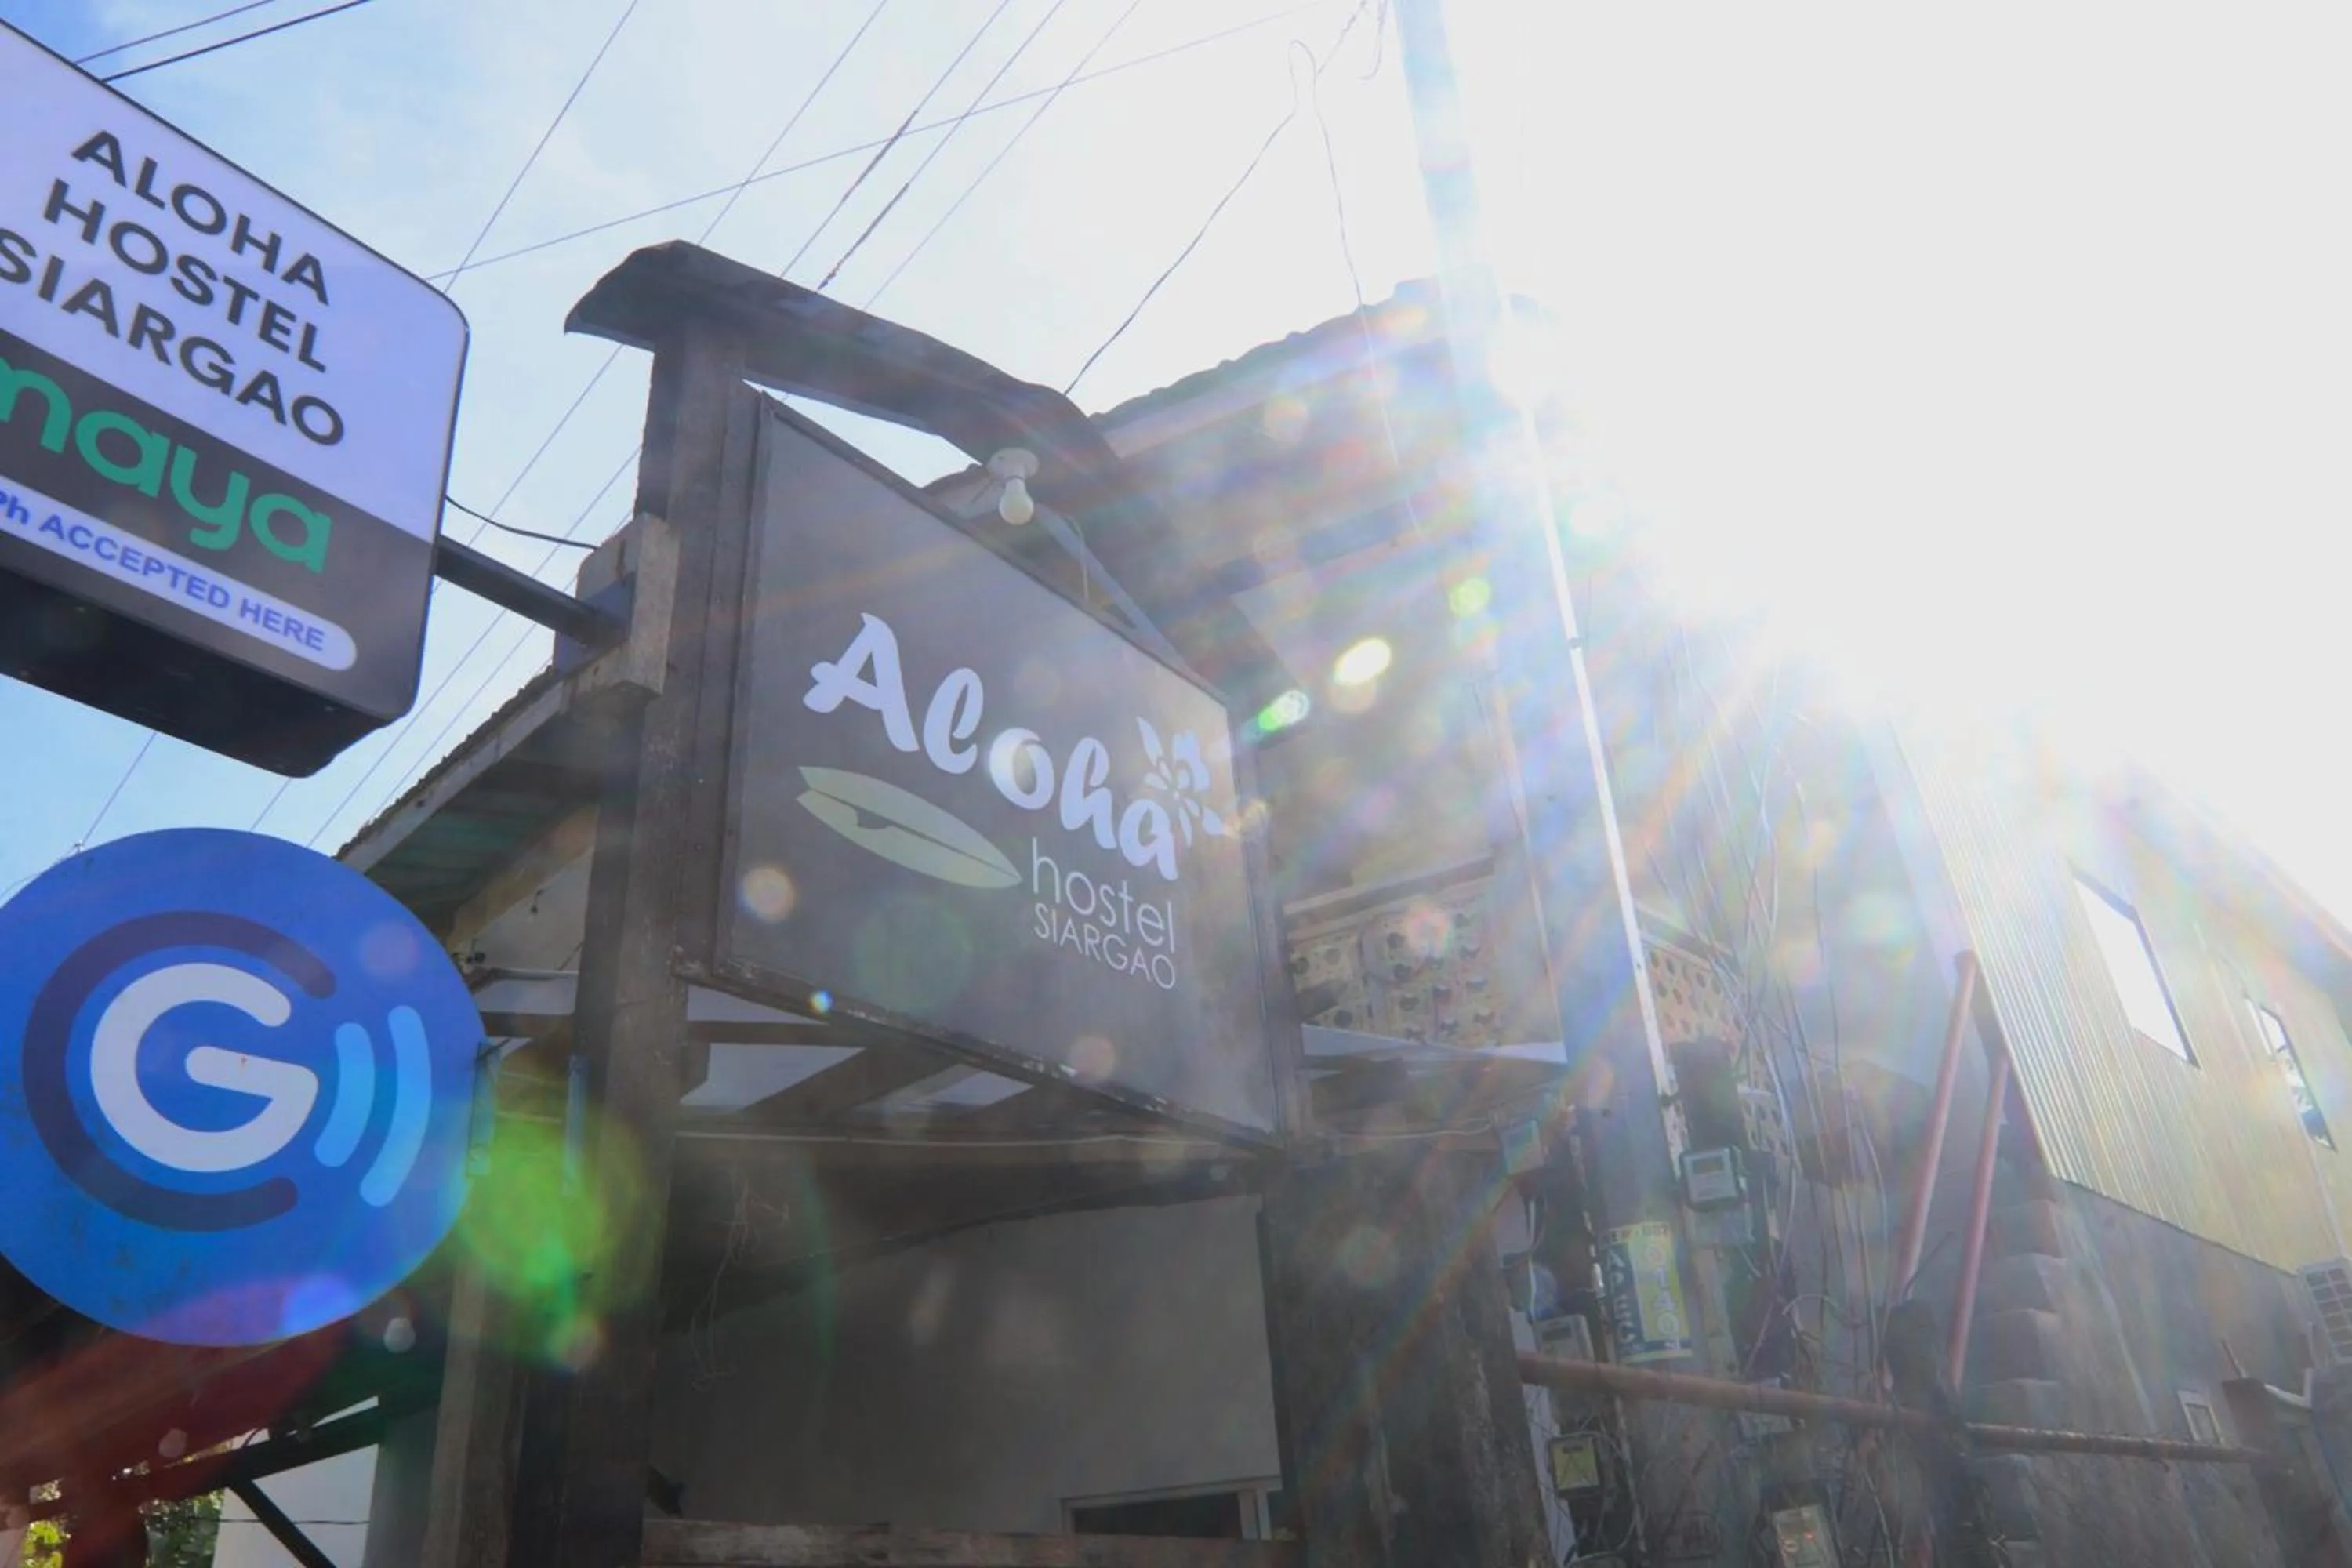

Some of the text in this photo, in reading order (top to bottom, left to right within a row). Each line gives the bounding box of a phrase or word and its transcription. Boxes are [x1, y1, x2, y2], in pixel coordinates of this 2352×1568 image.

[42, 177, 327, 372] HOSTEL
[71, 130, 330, 306] ALOHA
[0, 227, 345, 446] SIARGAO
[38, 514, 231, 609] ACCEPTED
[238, 597, 326, 652] HERE
[802, 612, 1178, 880] Aloha
[1031, 837, 1176, 954] hostel
[1033, 902, 1176, 989] SIARGAO
